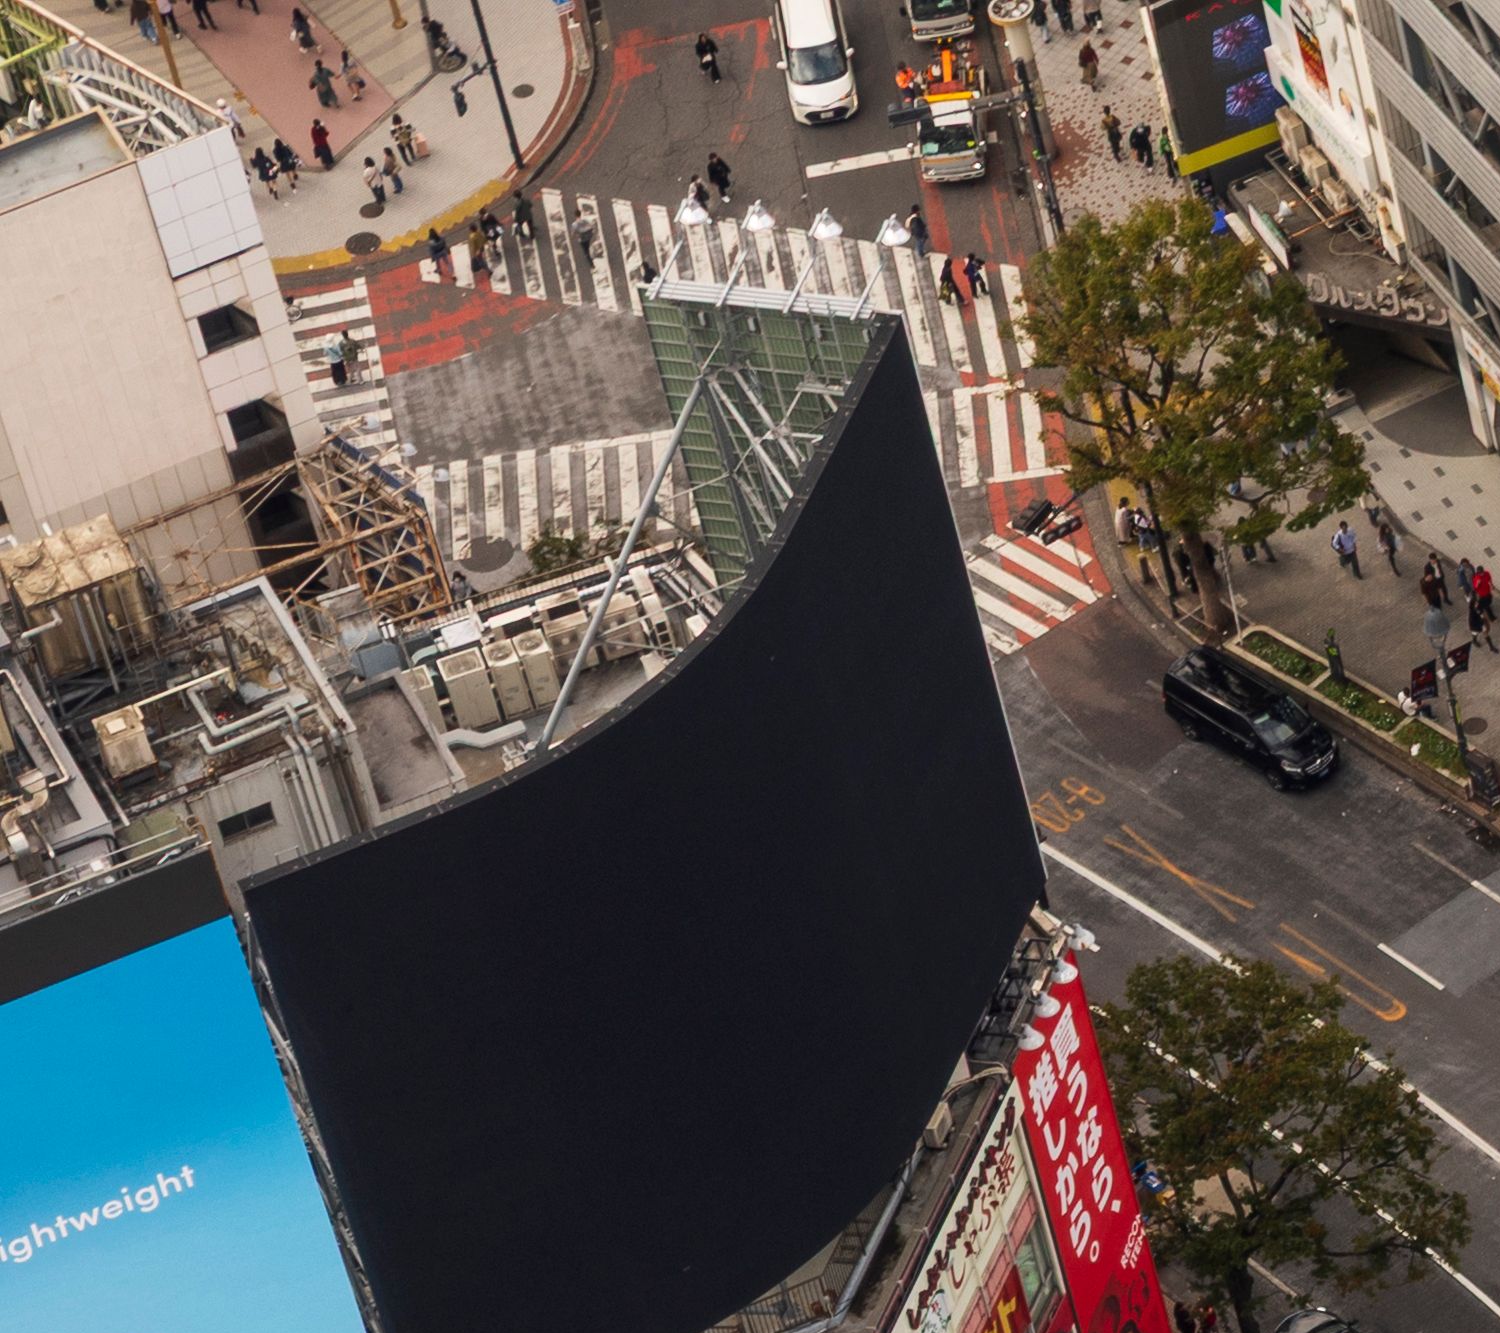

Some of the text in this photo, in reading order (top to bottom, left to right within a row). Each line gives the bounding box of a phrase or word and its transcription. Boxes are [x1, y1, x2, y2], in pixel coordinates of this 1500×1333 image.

[1028, 1049, 1100, 1264] 推しから。
[1050, 1002, 1122, 1214] 買うなら、
